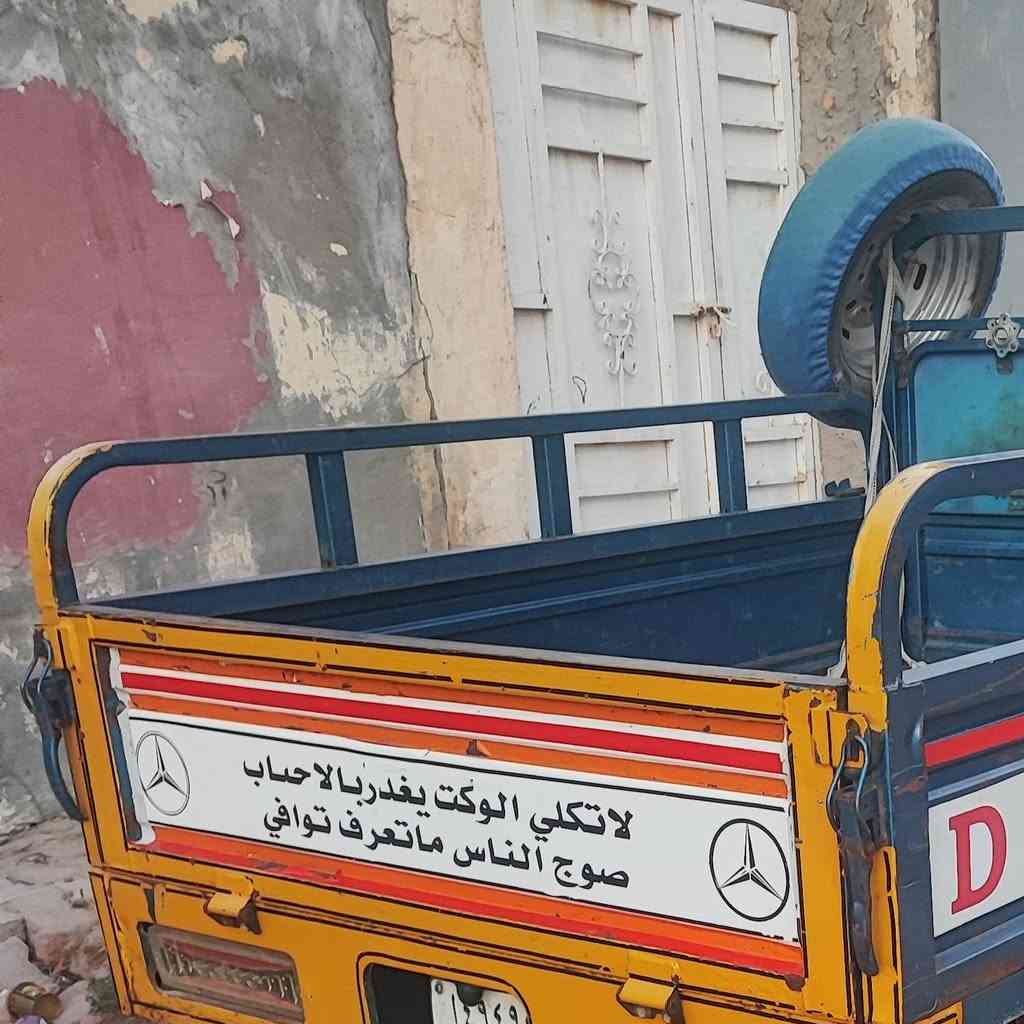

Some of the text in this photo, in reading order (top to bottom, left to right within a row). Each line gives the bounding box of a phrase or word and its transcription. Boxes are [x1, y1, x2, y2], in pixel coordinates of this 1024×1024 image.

[263, 797, 332, 839] توافي
[453, 837, 543, 873] الناس
[552, 855, 631, 890] صوج
